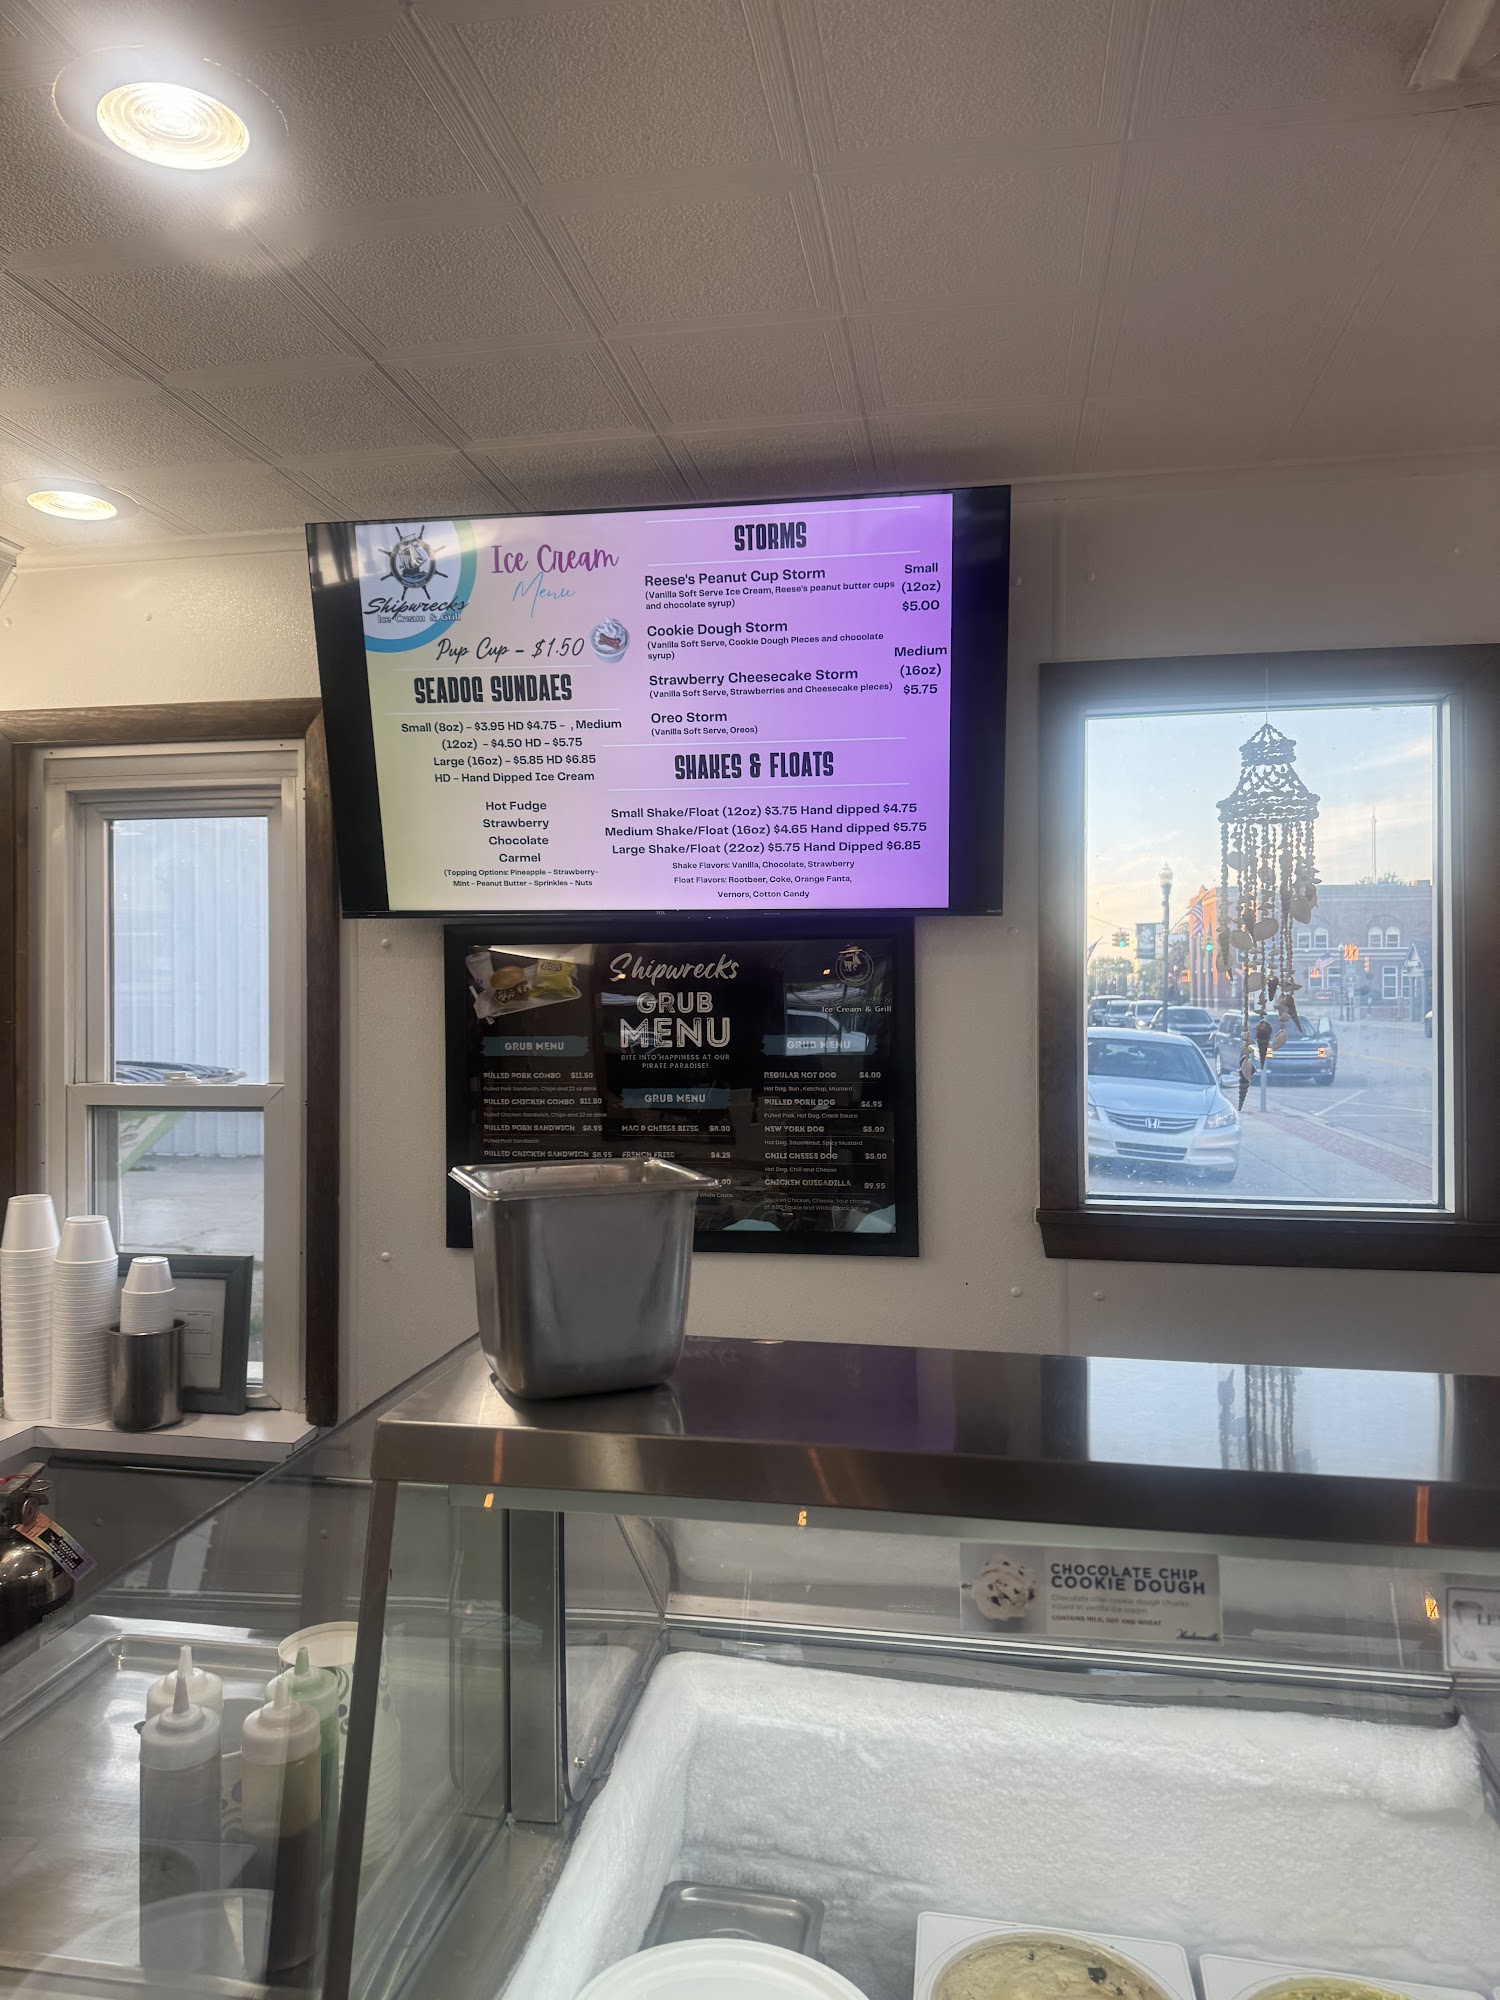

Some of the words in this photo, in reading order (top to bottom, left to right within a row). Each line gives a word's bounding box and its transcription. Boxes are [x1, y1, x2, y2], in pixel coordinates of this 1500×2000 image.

[734, 521, 807, 551] STORMS
[491, 545, 528, 573] Ice
[537, 544, 619, 573] Cream
[904, 562, 938, 573] Small
[644, 573, 695, 586] Reese's
[698, 571, 746, 584] Peanut
[750, 570, 778, 583] Cup
[782, 568, 825, 580] Storm
[645, 590, 676, 600] (Vanilla
[678, 589, 696, 597] Soft
[775, 585, 807, 593] Reese's
[809, 583, 841, 593] peanut
[872, 581, 894, 590] cups
[901, 579, 940, 594] (12oz)
[512, 572, 576, 618] Menu
[364, 596, 468, 619] Shipwrecks
[902, 599, 939, 611] $5.00
[378, 615, 391, 623] Ice
[395, 614, 425, 623] Cream
[429, 613, 437, 621] &
[441, 612, 461, 621] Grill
[647, 624, 693, 636] Cookie
[697, 621, 741, 636] Dough
[745, 621, 787, 633] Storm
[436, 638, 470, 664] Pup
[476, 637, 509, 662] Cup
[532, 638, 584, 657] $1.50
[894, 645, 947, 656] Medium
[900, 662, 941, 678] (16oz)
[649, 673, 724, 686] Strawberry
[728, 669, 811, 683] Cheesecake
[815, 669, 857, 680] Storm
[414, 676, 483, 704] SEADOG
[491, 674, 572, 701] SUNDAES
[903, 683, 937, 695] $5.75
[651, 712, 682, 723] Oreo
[686, 712, 727, 722] Storm
[401, 722, 431, 732] Small
[434, 721, 463, 733] (8oz)
[474, 721, 504, 731] $3.95
[507, 721, 523, 730] HD
[526, 720, 557, 730] $4.75
[651, 727, 681, 737] (Vanilla
[729, 725, 757, 734] Oreos)
[442, 738, 477, 750] (12oz)
[491, 738, 522, 748] $4.50
[525, 738, 541, 747] HD
[552, 737, 582, 747] $5.75
[433, 757, 464, 767] Large
[467, 754, 502, 767] (16oz)
[513, 755, 543, 764] $5.85
[546, 755, 562, 764] HD
[565, 754, 596, 763] $6.85
[675, 754, 741, 779] SHAKES
[750, 753, 761, 778] &
[769, 751, 834, 777] FLOATS
[434, 773, 450, 782] HD
[461, 772, 490, 782] Hand
[492, 771, 532, 783] Dipped
[535, 772, 554, 781] Ice
[557, 771, 594, 780] Cream
[485, 801, 506, 810] Hot
[509, 800, 546, 812] Fudge
[611, 808, 643, 818] Small
[646, 807, 719, 817] Shake/Float
[722, 805, 761, 818] (12oz)
[764, 805, 797, 815] $3.75
[800, 804, 832, 814] Hand
[836, 803, 879, 816] dipped
[883, 803, 917, 813] $4.75
[482, 818, 549, 829] Strawberry
[488, 835, 548, 845] Chocolate
[499, 852, 540, 862] Carmel
[731, 861, 760, 869] Vanilla,
[762, 860, 806, 868] Chocolate,
[807, 860, 854, 868] Strawberry
[443, 869, 477, 877] (Topping
[510, 868, 546, 876] Pineapple
[533, 879, 568, 887] Sprinkles
[610, 953, 739, 986] Shipwrecks
[637, 992, 713, 1014] GRUB
[620, 1018, 730, 1048] MENU
[505, 1042, 532, 1050] GRUB
[536, 1042, 564, 1050] MENU
[787, 1041, 816, 1049] GRUB
[645, 1094, 673, 1102] GRUB
[676, 1094, 705, 1102] MENU
[1051, 1563, 1151, 1578] CHOCOLATE
[1159, 1569, 1197, 1580] CHIP
[1051, 1577, 1126, 1591] COOKIE
[1135, 1580, 1205, 1595] DOUGH
